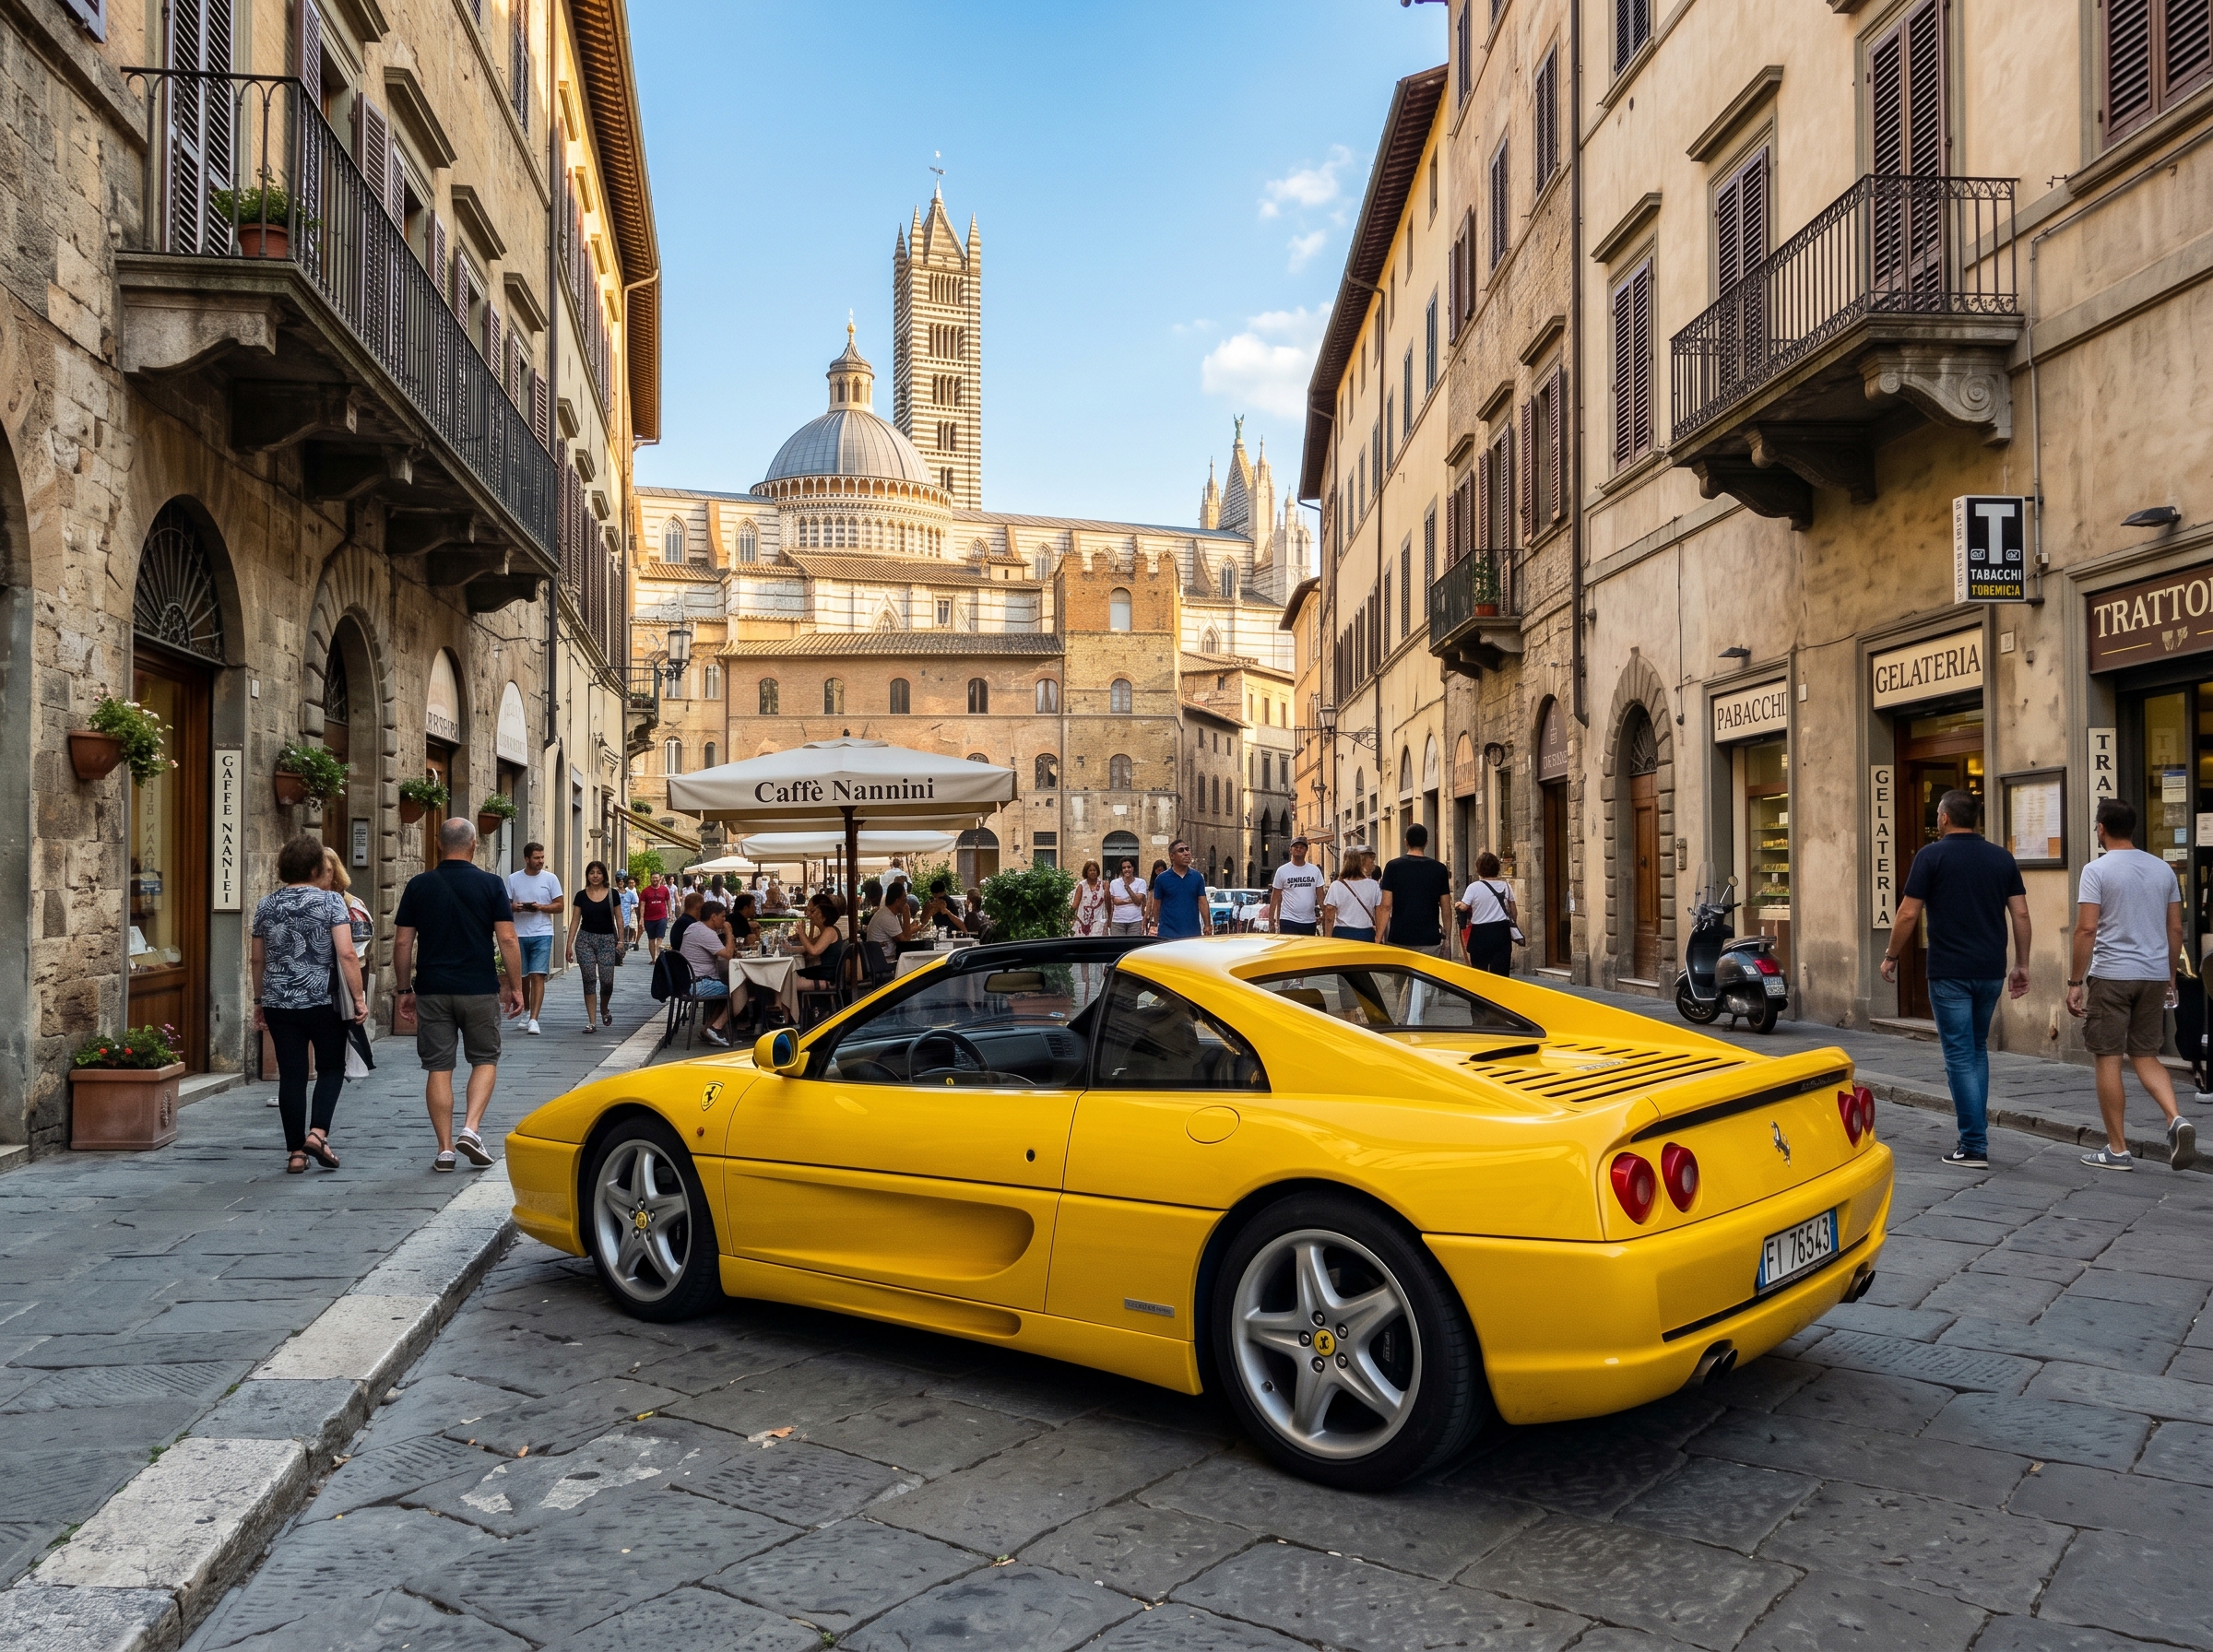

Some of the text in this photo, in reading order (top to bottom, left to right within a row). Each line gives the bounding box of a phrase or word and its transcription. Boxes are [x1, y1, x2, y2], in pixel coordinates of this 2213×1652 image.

[1975, 503, 2015, 564] T
[1970, 569, 2022, 581] TABACCHI
[1875, 643, 1982, 694] GELATERIA
[754, 777, 935, 803] Caffè Nannini
[1876, 770, 1890, 925] GELATERIA
[1766, 1216, 1830, 1280] FI 76543
